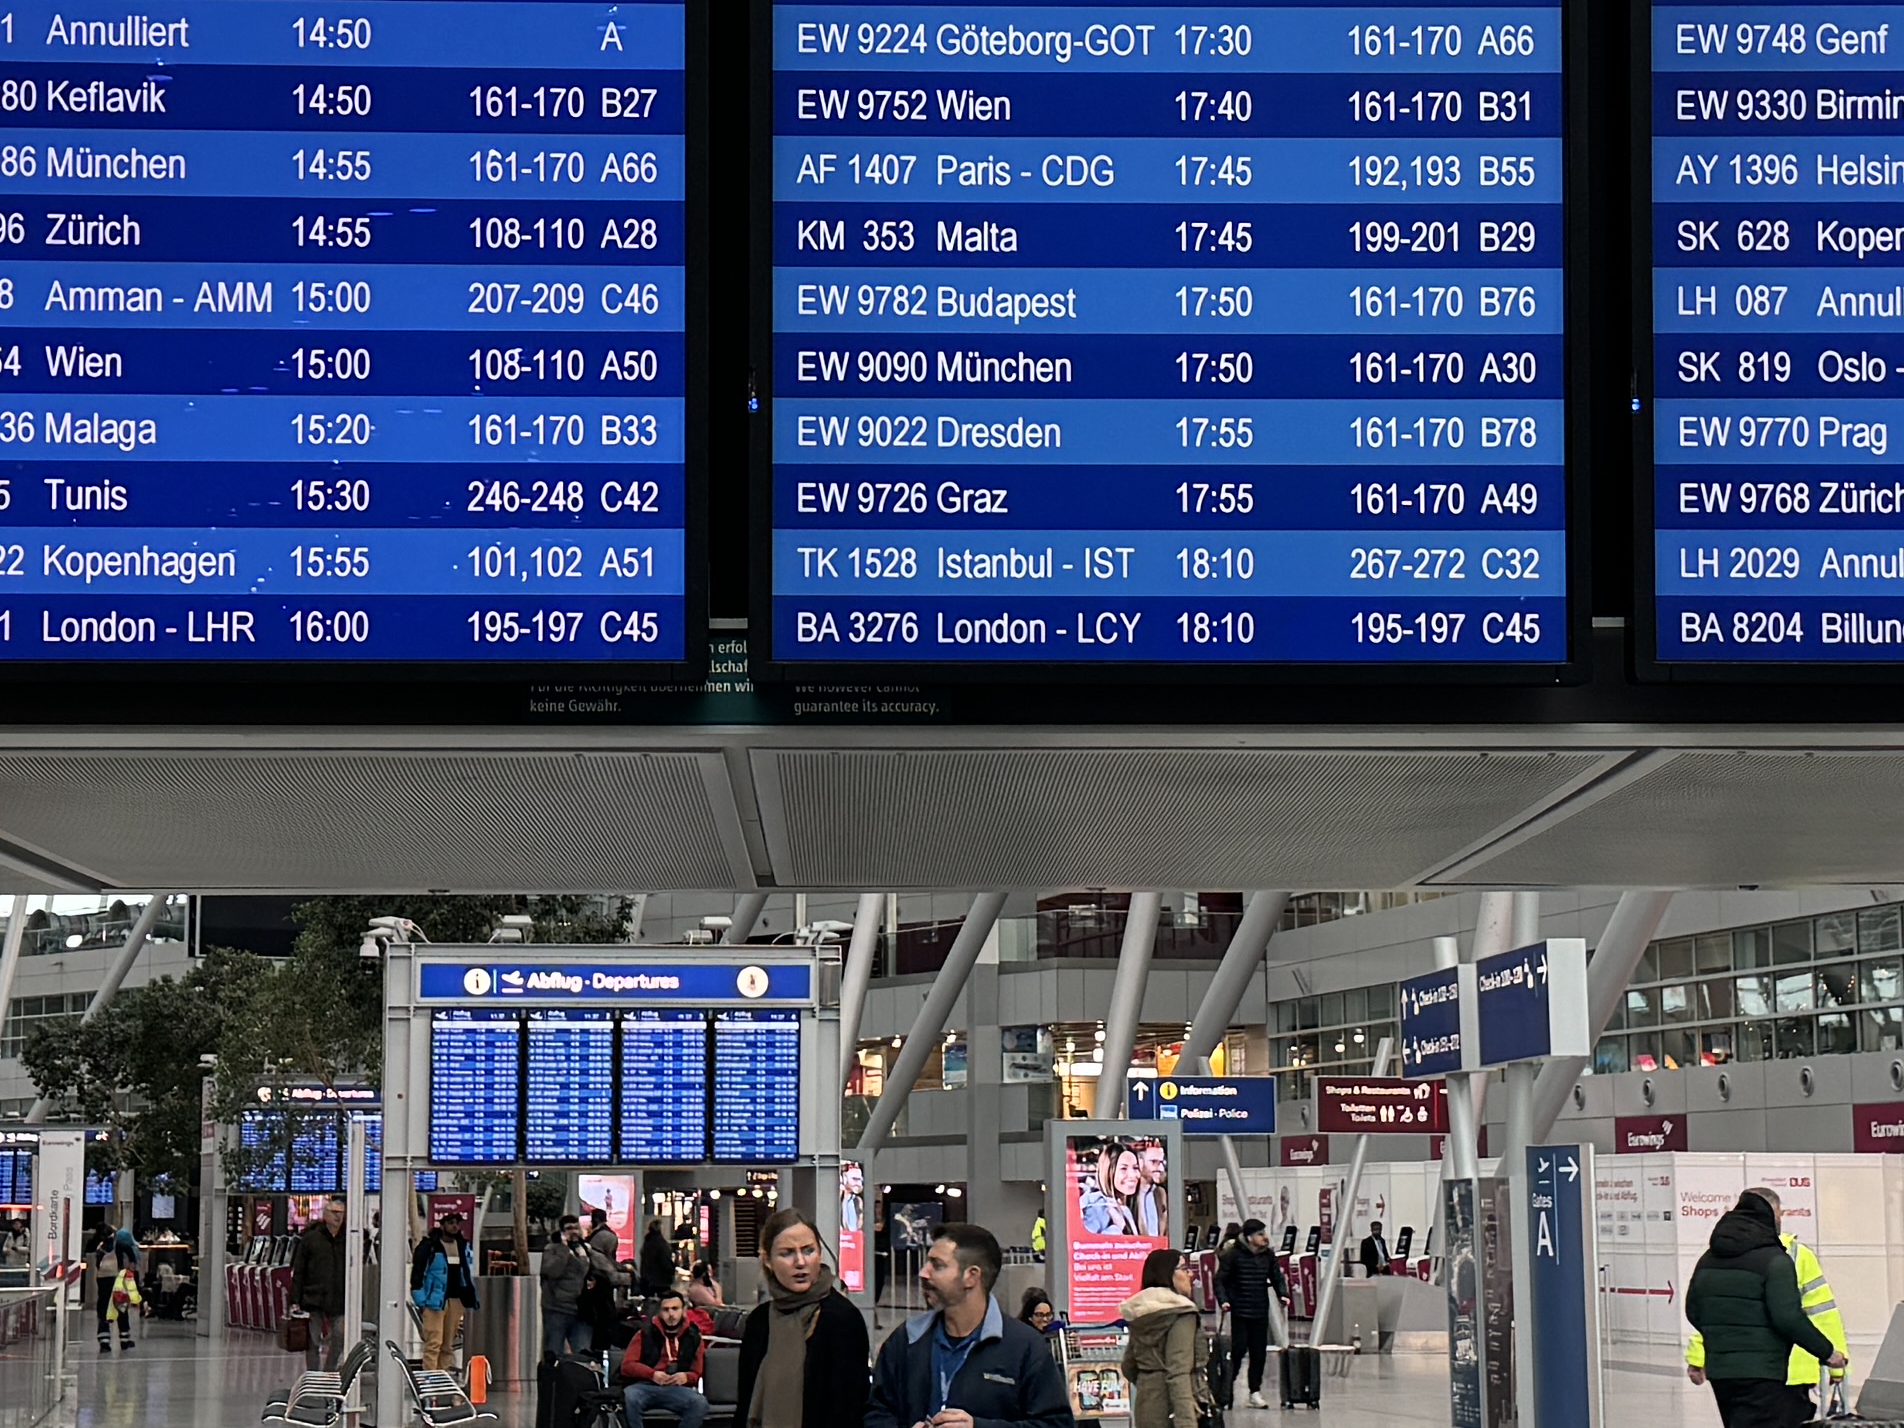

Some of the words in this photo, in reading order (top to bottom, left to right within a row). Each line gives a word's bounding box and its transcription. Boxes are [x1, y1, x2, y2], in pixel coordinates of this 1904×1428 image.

[798, 23, 850, 53] EW
[857, 22, 928, 54] 9224
[936, 23, 1156, 63] Göteborg-GOT
[1175, 24, 1252, 56] 17:30
[1348, 24, 1462, 56] 161-170
[1477, 24, 1535, 56] A66
[1677, 90, 1729, 120] EW
[1736, 89, 1807, 121] 9330
[45, 213, 140, 246] Zürich
[292, 215, 371, 248] 14:55
[469, 217, 585, 249] 108-110
[600, 218, 658, 250] A28
[797, 482, 850, 513] EW
[857, 482, 928, 513] 9726
[936, 481, 1008, 514] Graz
[1176, 482, 1254, 514] 17:55
[1350, 482, 1465, 515] 161-170
[1480, 482, 1538, 515] A49
[1681, 612, 1724, 643] BA
[1732, 611, 1804, 643] 8204
[718, 639, 747, 653] erfol
[529, 699, 565, 712] keine
[568, 698, 622, 712] Gewähr.
[794, 700, 859, 716] guarantee
[862, 698, 878, 713] its
[881, 701, 940, 716] accuracy.
[526, 972, 583, 992] Abflug
[592, 972, 680, 992] Departures
[1180, 1084, 1238, 1097] Information
[1180, 1107, 1214, 1120] Polizei
[1627, 1130, 1665, 1150] Eurowings
[1680, 1191, 1732, 1204] Welcome
[1680, 1205, 1719, 1219] Shops
[1536, 1210, 1555, 1257] A
